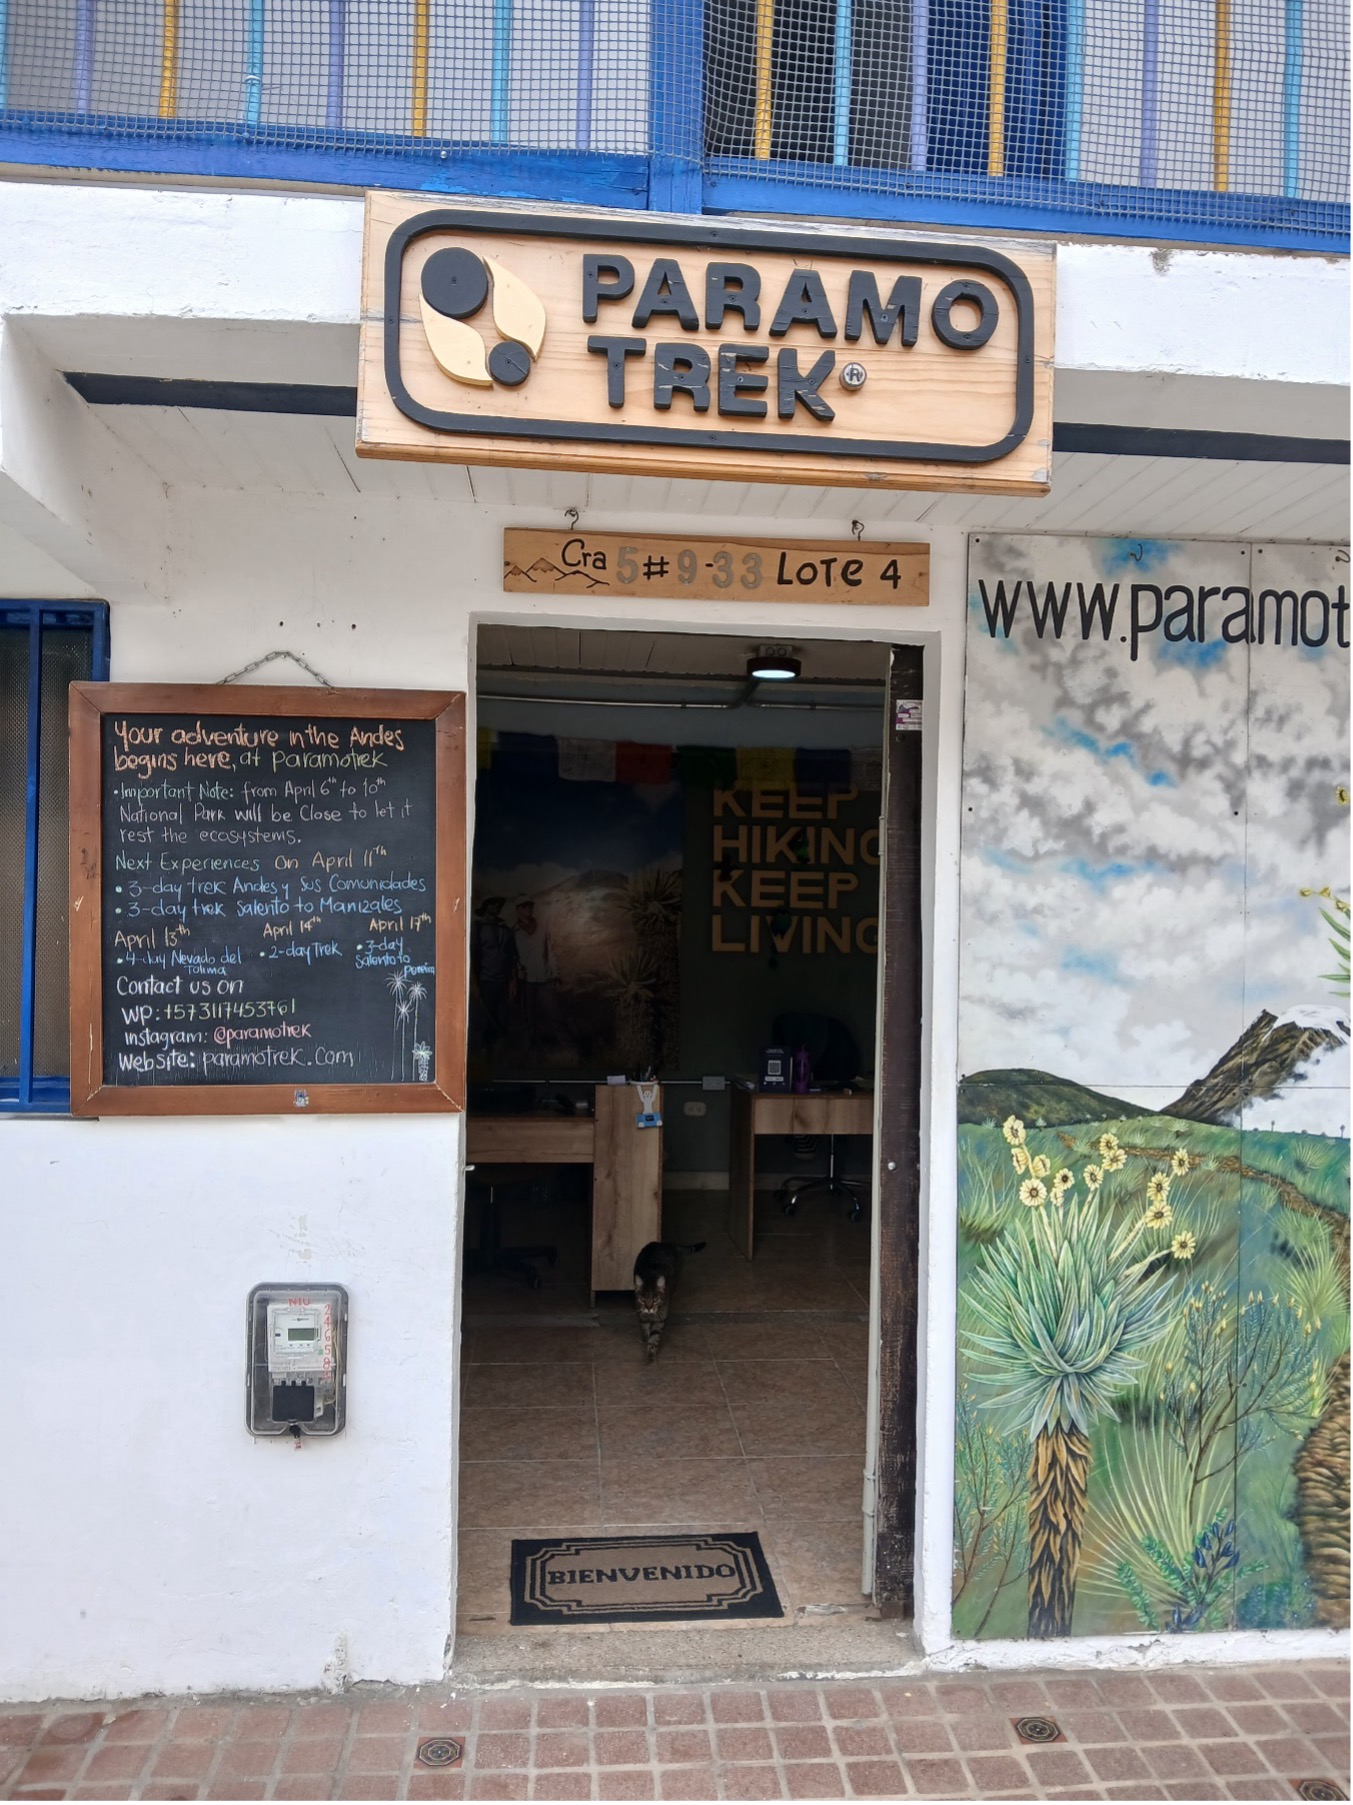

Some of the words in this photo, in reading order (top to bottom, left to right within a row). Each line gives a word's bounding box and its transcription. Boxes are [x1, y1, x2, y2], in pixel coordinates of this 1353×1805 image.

[582, 254, 999, 350] PARAMO
[587, 335, 836, 421] TREK
[561, 539, 607, 570] Cra
[880, 559, 901, 589] 4
[978, 579, 1350, 661] www.paramot
[114, 720, 163, 752] Your
[171, 720, 279, 748] adventure
[350, 724, 405, 751] Andes
[114, 745, 178, 779] begins
[184, 746, 236, 773] here,
[239, 748, 261, 767] at
[121, 779, 194, 808] Important
[199, 781, 234, 800] Note:
[241, 781, 277, 805] from
[284, 780, 315, 804] April
[340, 781, 357, 798] to
[120, 802, 183, 825] National
[194, 802, 226, 822] Park
[234, 802, 262, 823] will
[348, 801, 367, 821] to
[375, 799, 396, 819] let
[401, 798, 413, 818] it
[120, 826, 155, 843] rest
[162, 826, 188, 844] the
[199, 826, 302, 847] ecosystems.
[115, 850, 153, 871] Next
[160, 851, 260, 876] Experiences
[312, 848, 353, 873] April
[128, 876, 182, 902] 3-day
[232, 876, 278, 895] Andes
[281, 882, 290, 900] y
[329, 871, 426, 893] Comunidades
[712, 869, 858, 909] KEEP
[127, 898, 186, 923] 3-day
[192, 898, 226, 917] trek
[294, 896, 314, 913] to
[320, 895, 402, 914] Manizales
[114, 928, 156, 952] April
[164, 923, 191, 947] 13th
[263, 921, 293, 941] April
[369, 916, 404, 933] April
[171, 947, 216, 967] Nevado
[220, 945, 242, 965] del
[268, 941, 310, 966] 2-day
[311, 940, 343, 958] Trek
[364, 936, 404, 955] 3-day
[398, 951, 411, 964] to
[116, 975, 183, 996] Contact
[189, 980, 211, 995] us
[217, 979, 244, 995] on
[125, 1027, 207, 1050] Instagram:
[547, 1563, 736, 1586] BIENVENIDO
